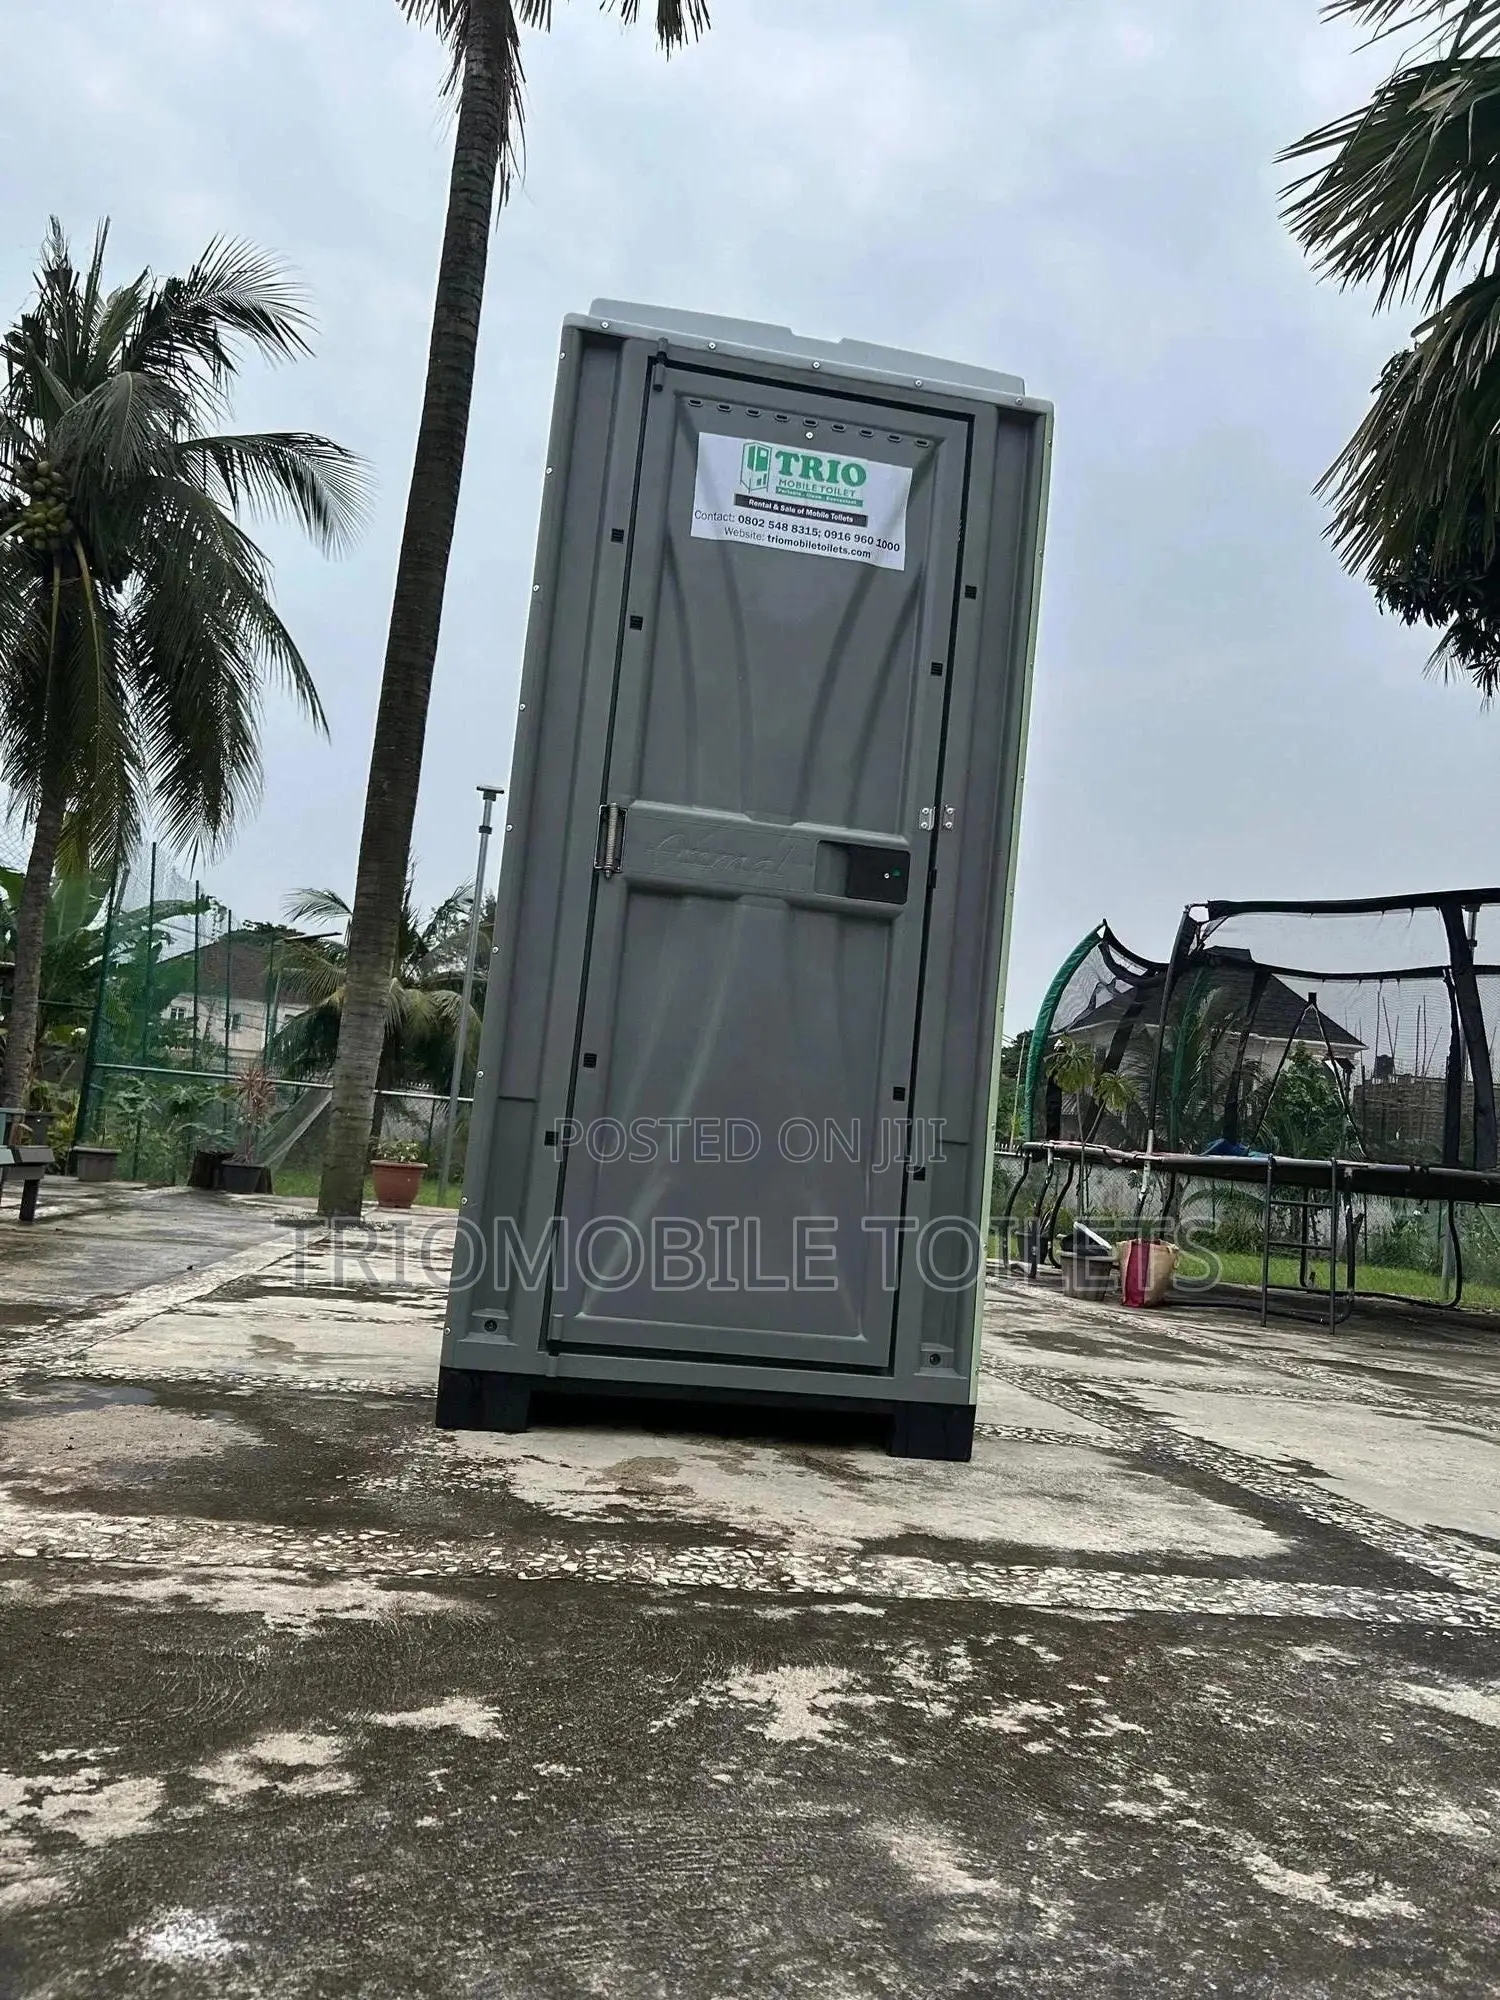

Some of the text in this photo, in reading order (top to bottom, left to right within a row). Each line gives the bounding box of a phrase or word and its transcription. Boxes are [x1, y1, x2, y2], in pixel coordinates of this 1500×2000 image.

[775, 451, 866, 487] TRIO
[778, 480, 856, 497] MOBILE TOILET
[748, 499, 772, 509] Rental
[780, 504, 796, 514] Sale
[797, 507, 805, 515] of
[806, 509, 829, 519] Mobile
[831, 512, 853, 523] Toilets
[694, 510, 900, 552] Contact: 0802 548 8315; 0916 960 1000
[724, 527, 871, 558] Website: triomobiletoilets.com
